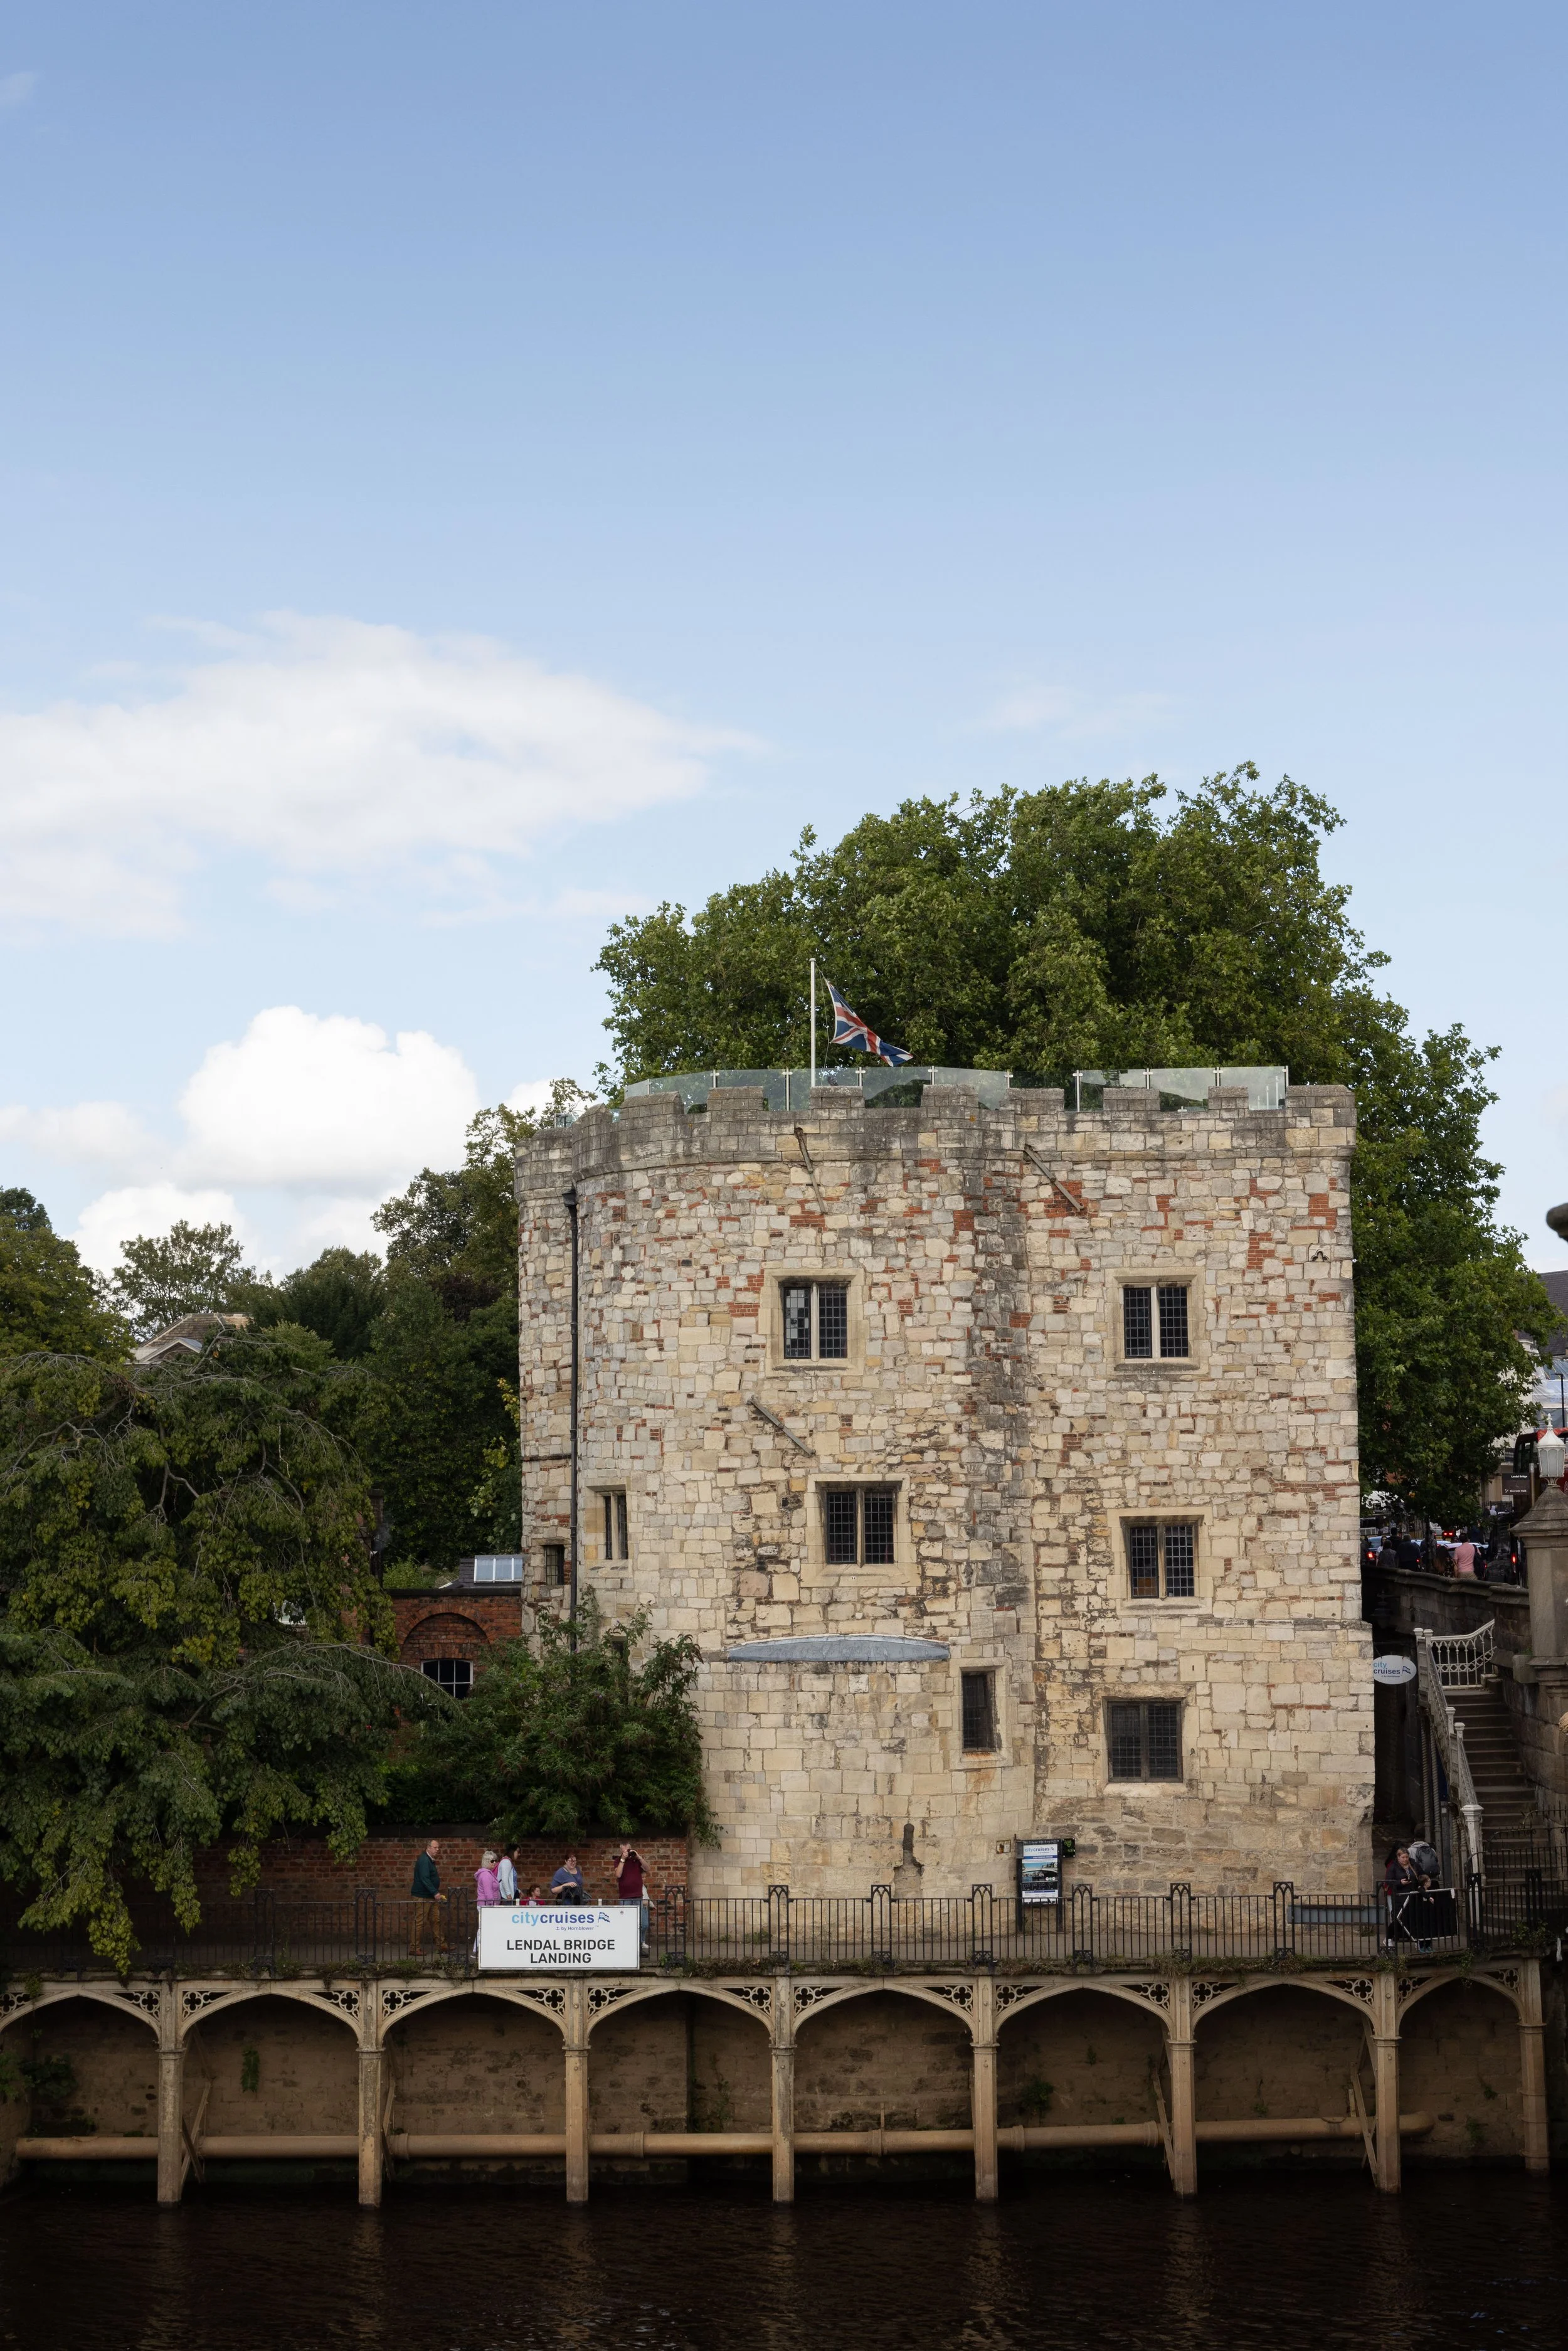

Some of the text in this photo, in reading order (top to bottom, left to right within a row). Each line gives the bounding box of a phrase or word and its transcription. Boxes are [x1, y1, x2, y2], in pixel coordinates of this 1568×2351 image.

[511, 1911, 595, 1926] citycruises
[507, 1940, 615, 1950] LENDAL BRIDGE
[530, 1953, 591, 1963] LANDING
